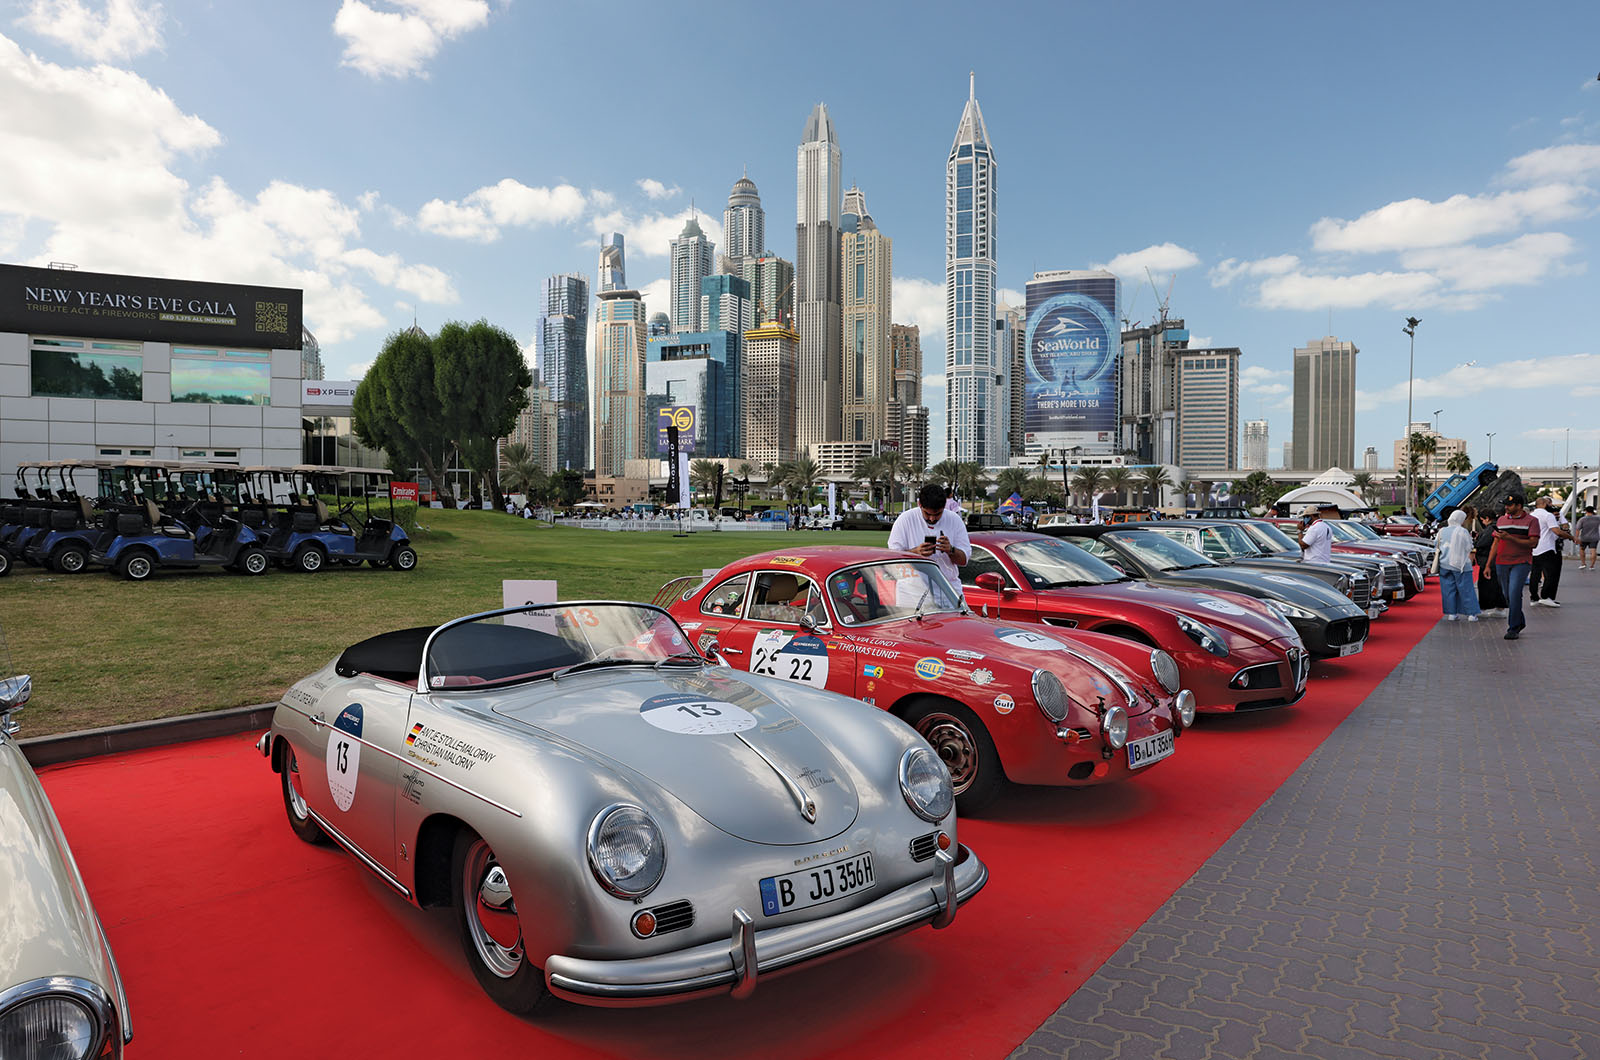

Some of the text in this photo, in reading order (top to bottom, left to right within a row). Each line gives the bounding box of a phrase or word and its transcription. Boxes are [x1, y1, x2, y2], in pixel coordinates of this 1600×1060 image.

[25, 286, 236, 316] NEW YEAR'S EVE GALA
[26, 303, 68, 314] TRIBUTE
[70, 306, 90, 315] ACT
[102, 309, 156, 320] FIREWORKS
[1037, 337, 1099, 352] SeaWorld
[1037, 400, 1100, 409] THERE'S MORE TO SEA
[659, 407, 694, 432] 50
[392, 486, 416, 496] Emirates
[562, 607, 600, 628] 13
[845, 634, 900, 647] SILVIA LUNDT
[1016, 633, 1045, 643] 22
[838, 642, 901, 660] THOMAS LUNDT
[789, 658, 812, 681] 22
[917, 662, 945, 675] HELLA
[677, 704, 722, 718] 13
[995, 699, 1014, 709] Gulf
[420, 726, 496, 763] ANTJE STOLLE-MALORNY
[1134, 731, 1174, 761] B LT 356H
[336, 740, 349, 775] 13
[414, 738, 476, 771] CHRISTIAN MALORNY
[779, 856, 874, 907] B JJ 356H
[767, 901, 775, 910] D
